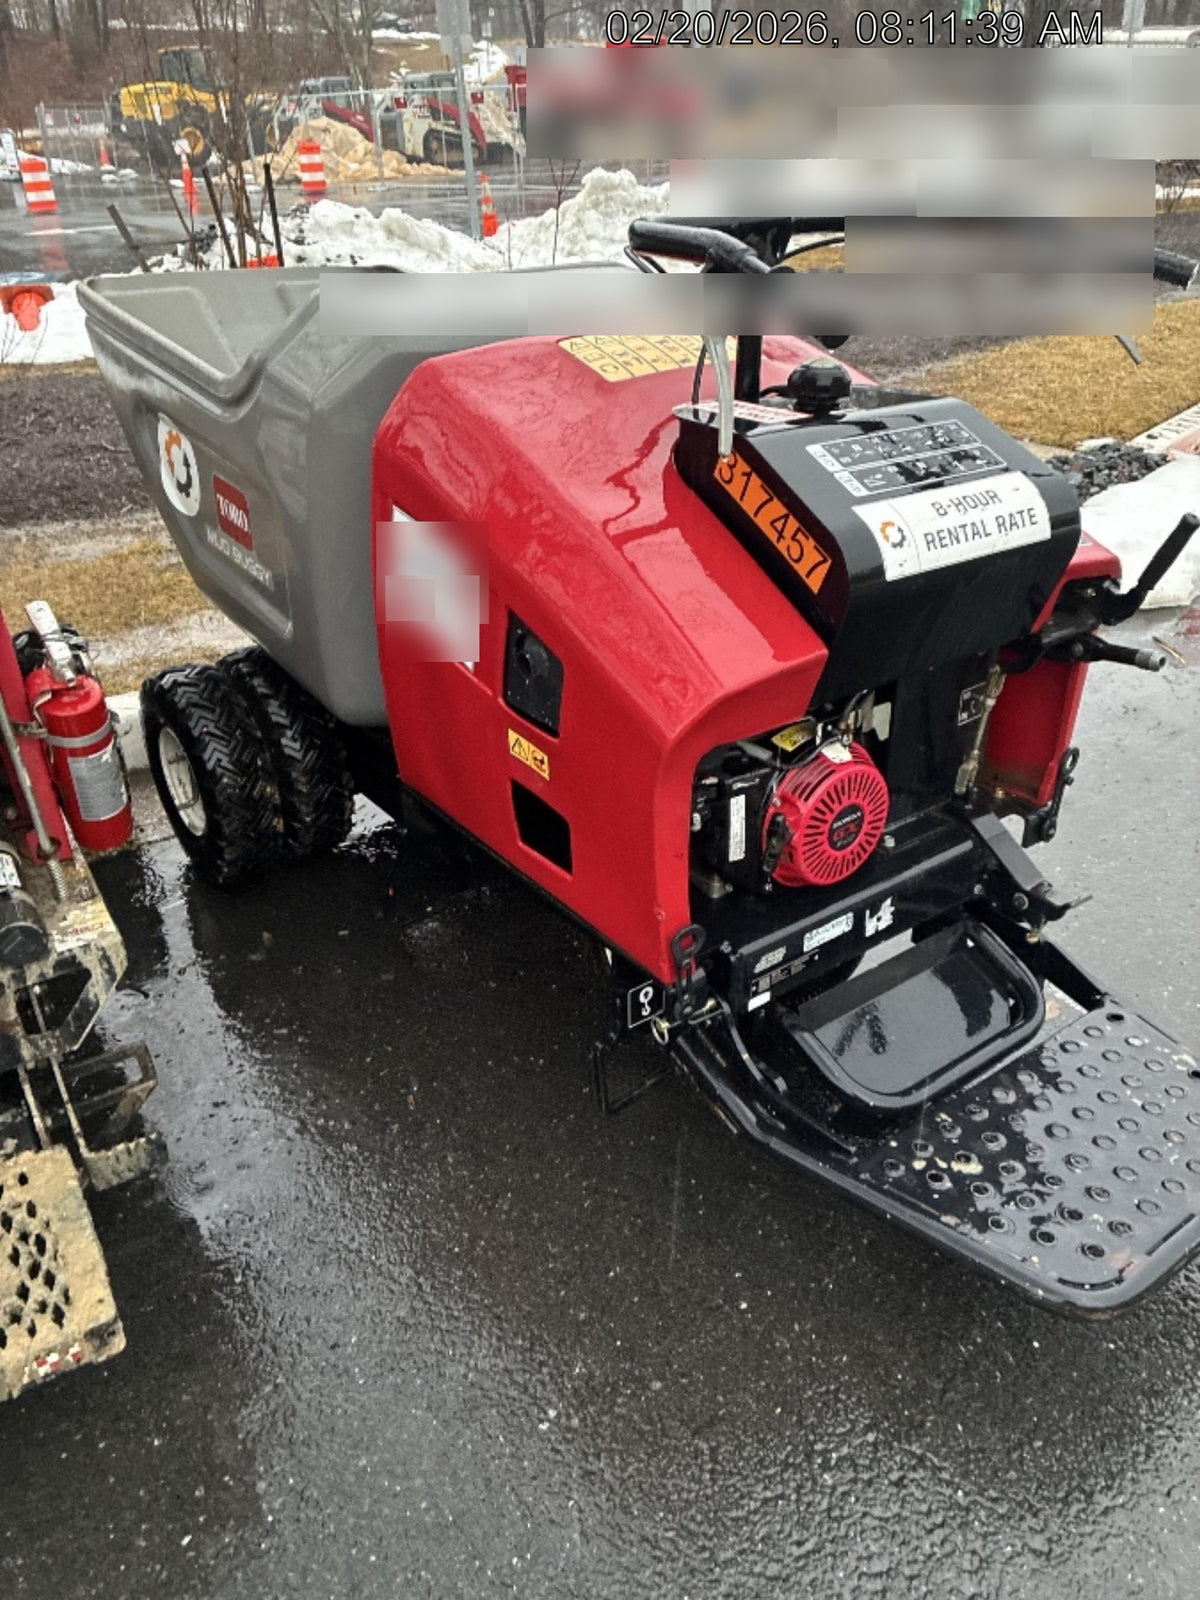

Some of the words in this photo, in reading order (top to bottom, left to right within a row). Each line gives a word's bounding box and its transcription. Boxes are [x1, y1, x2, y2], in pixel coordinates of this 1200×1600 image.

[216, 492, 248, 532] TORO
[719, 451, 829, 579] 317457
[923, 519, 992, 552] RENTAL
[995, 508, 1039, 535] RATE
